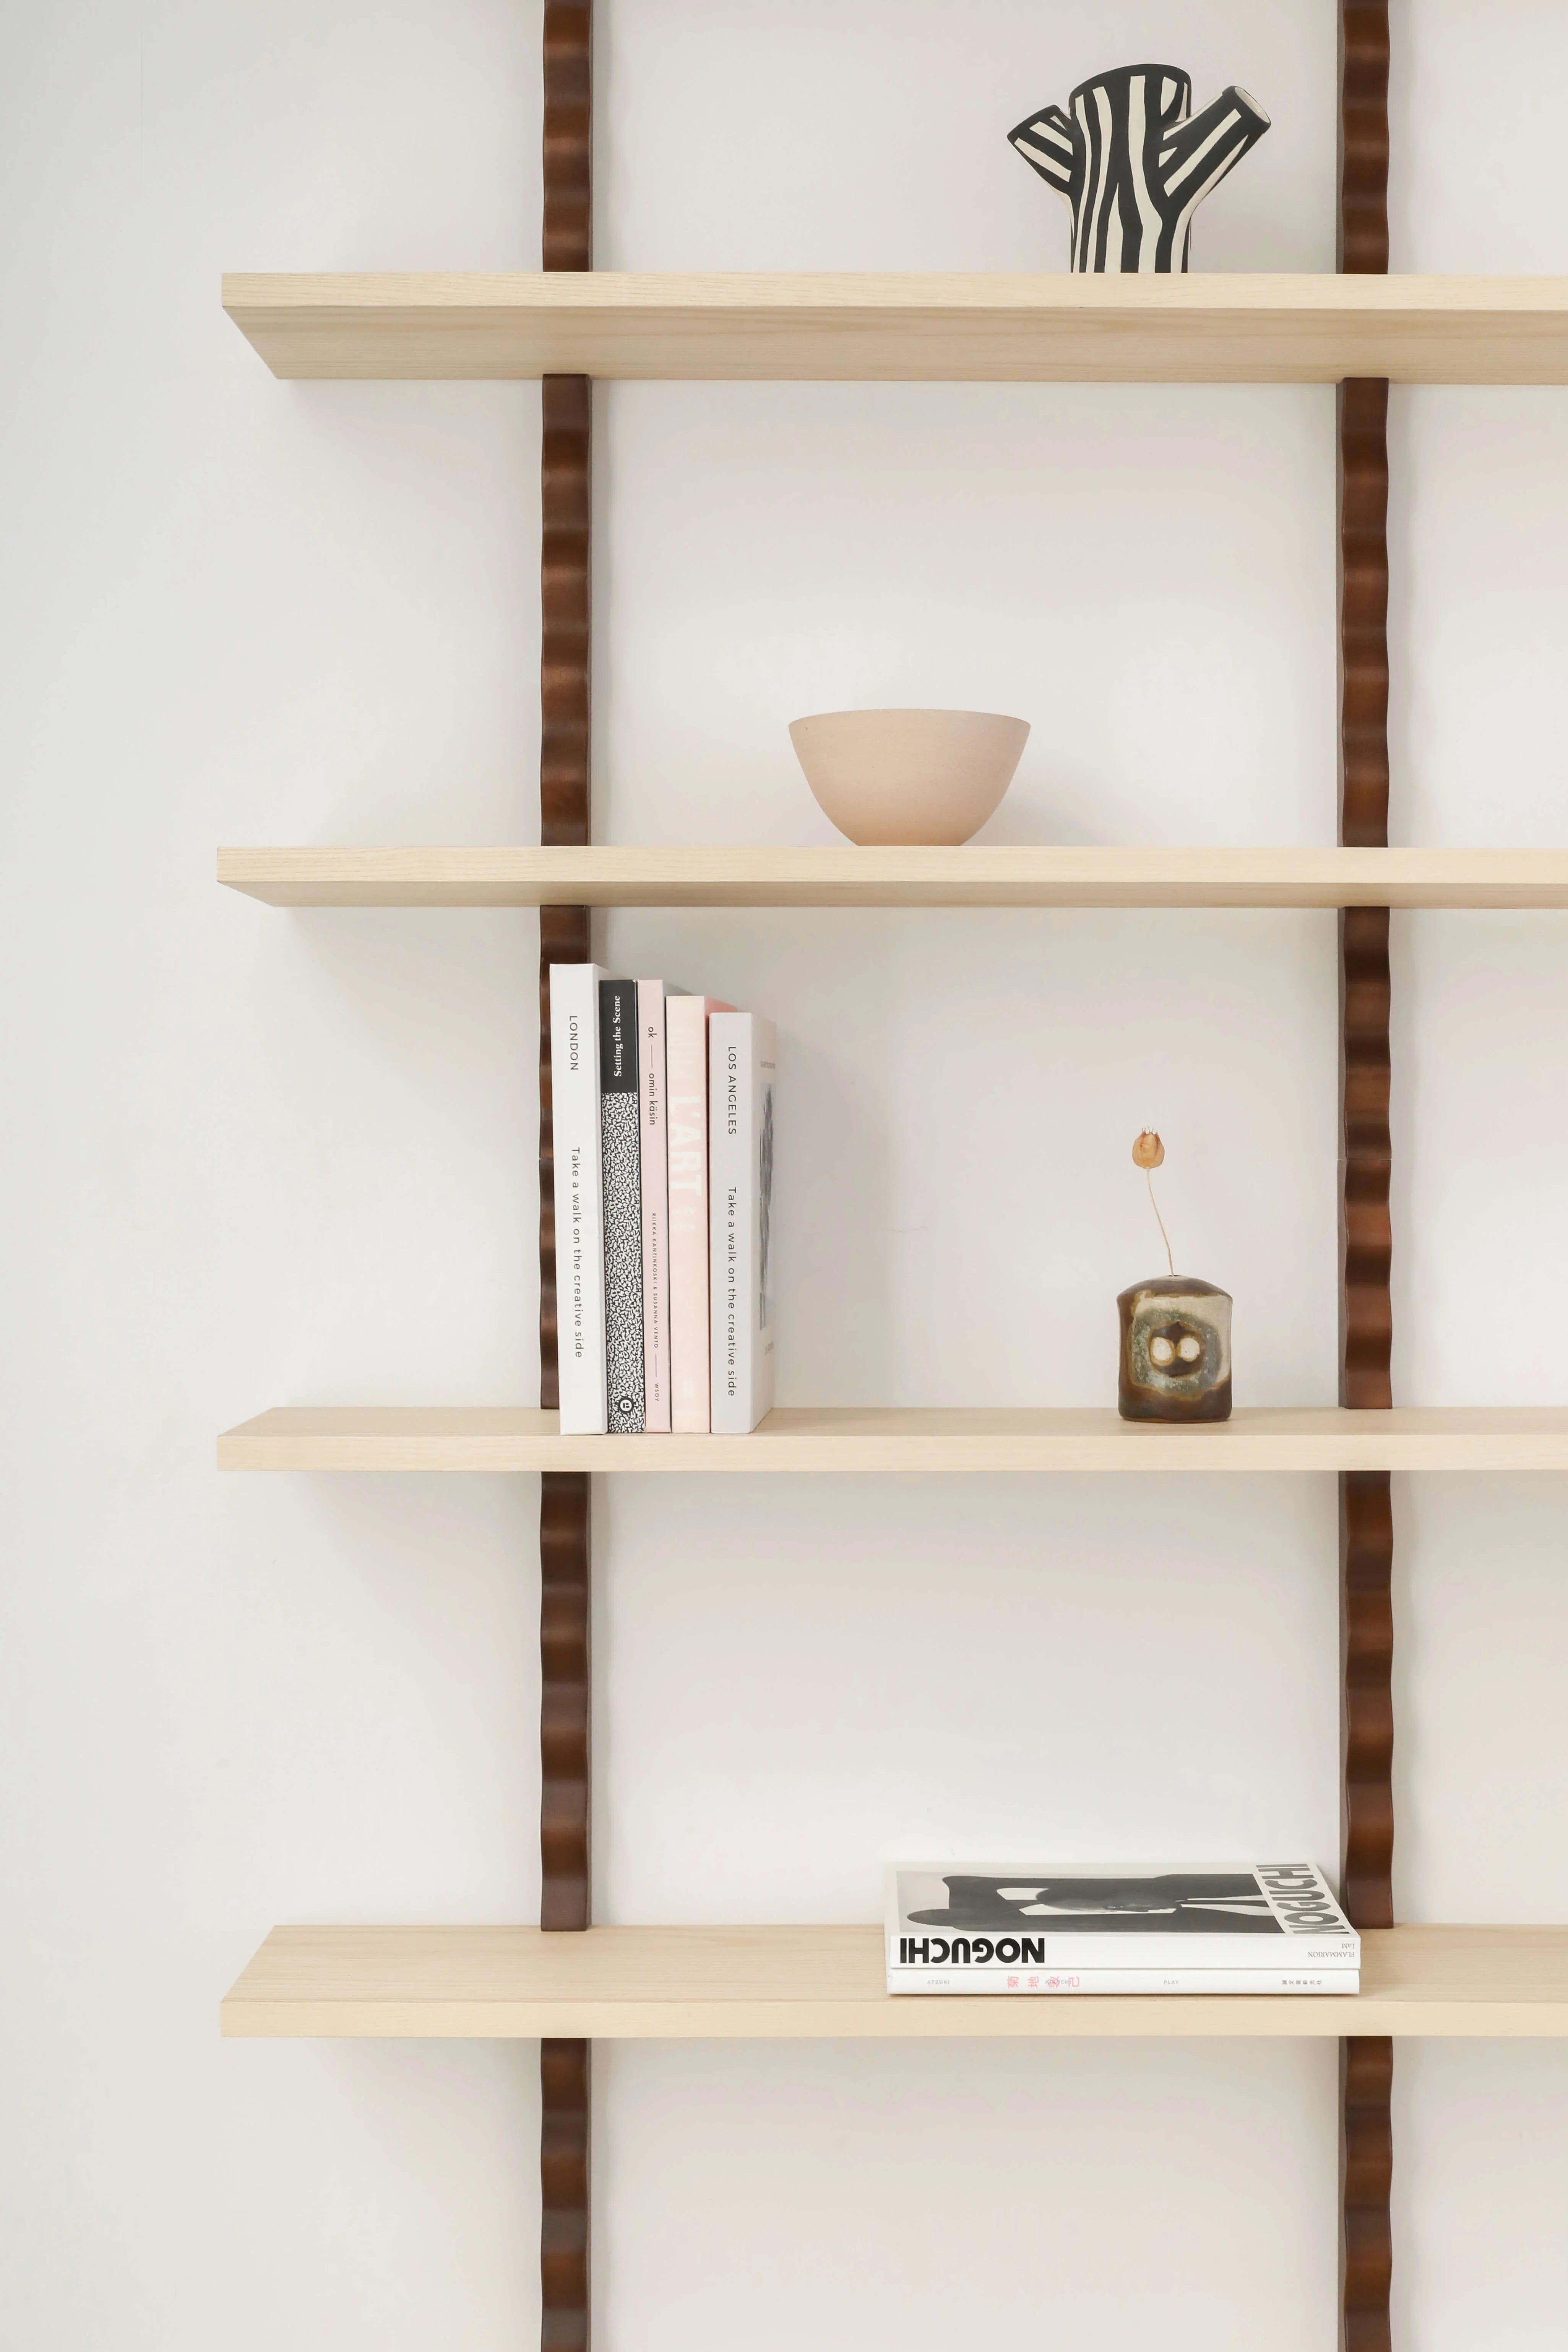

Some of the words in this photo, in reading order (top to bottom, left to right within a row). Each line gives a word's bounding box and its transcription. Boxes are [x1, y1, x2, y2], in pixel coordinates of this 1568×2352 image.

[612, 995, 621, 1023] Scene
[569, 1016, 578, 1070] LONDON
[612, 1026, 621, 1041] the
[648, 1026, 657, 1038] ok
[614, 1043, 623, 1076] Setting
[728, 1047, 737, 1070] LOS
[649, 1073, 657, 1096] omin
[649, 1101, 658, 1125] käsin
[728, 1075, 736, 1135] ANGELES
[571, 1147, 581, 1177] Take
[572, 1193, 582, 1223] walk
[728, 1187, 737, 1216] Take
[573, 1229, 580, 1243] on
[728, 1233, 737, 1262] walk
[573, 1249, 582, 1269] the
[728, 1268, 735, 1282] on
[574, 1275, 583, 1326] creative
[728, 1289, 737, 1308] the
[575, 1332, 584, 1358] side
[728, 1314, 737, 1365] creative
[728, 1370, 737, 1396] side
[1256, 1863, 1350, 1934] NOGUCHI
[900, 1938, 1045, 1964] NOGUCHI
